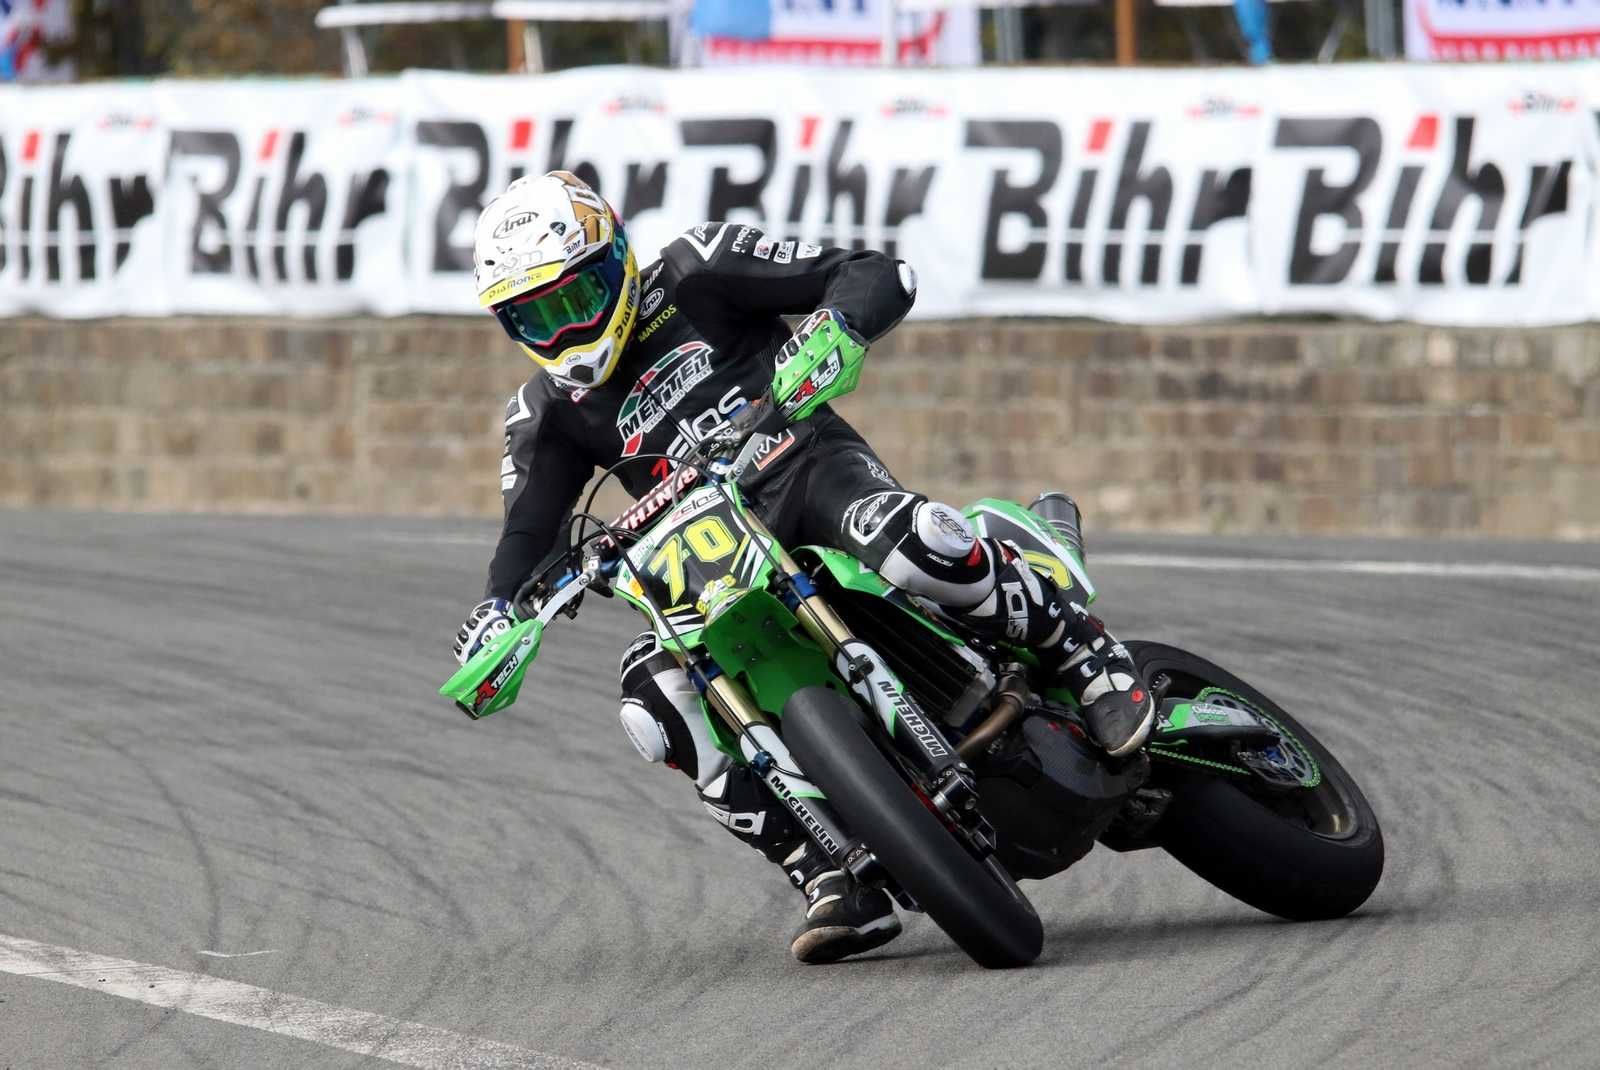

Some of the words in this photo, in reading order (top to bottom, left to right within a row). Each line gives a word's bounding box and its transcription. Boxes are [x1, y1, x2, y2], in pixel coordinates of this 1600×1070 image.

[0, 128, 157, 284] ihr
[166, 128, 392, 284] Bihr
[496, 211, 538, 238] Arai
[680, 117, 936, 258] Bihr
[964, 119, 1253, 285] Bihr
[1275, 114, 1574, 286] Bihr
[638, 303, 678, 342] MARTOS
[648, 516, 738, 607] 70
[877, 680, 949, 758] MICHELIN
[770, 775, 840, 855] MICHELIN
